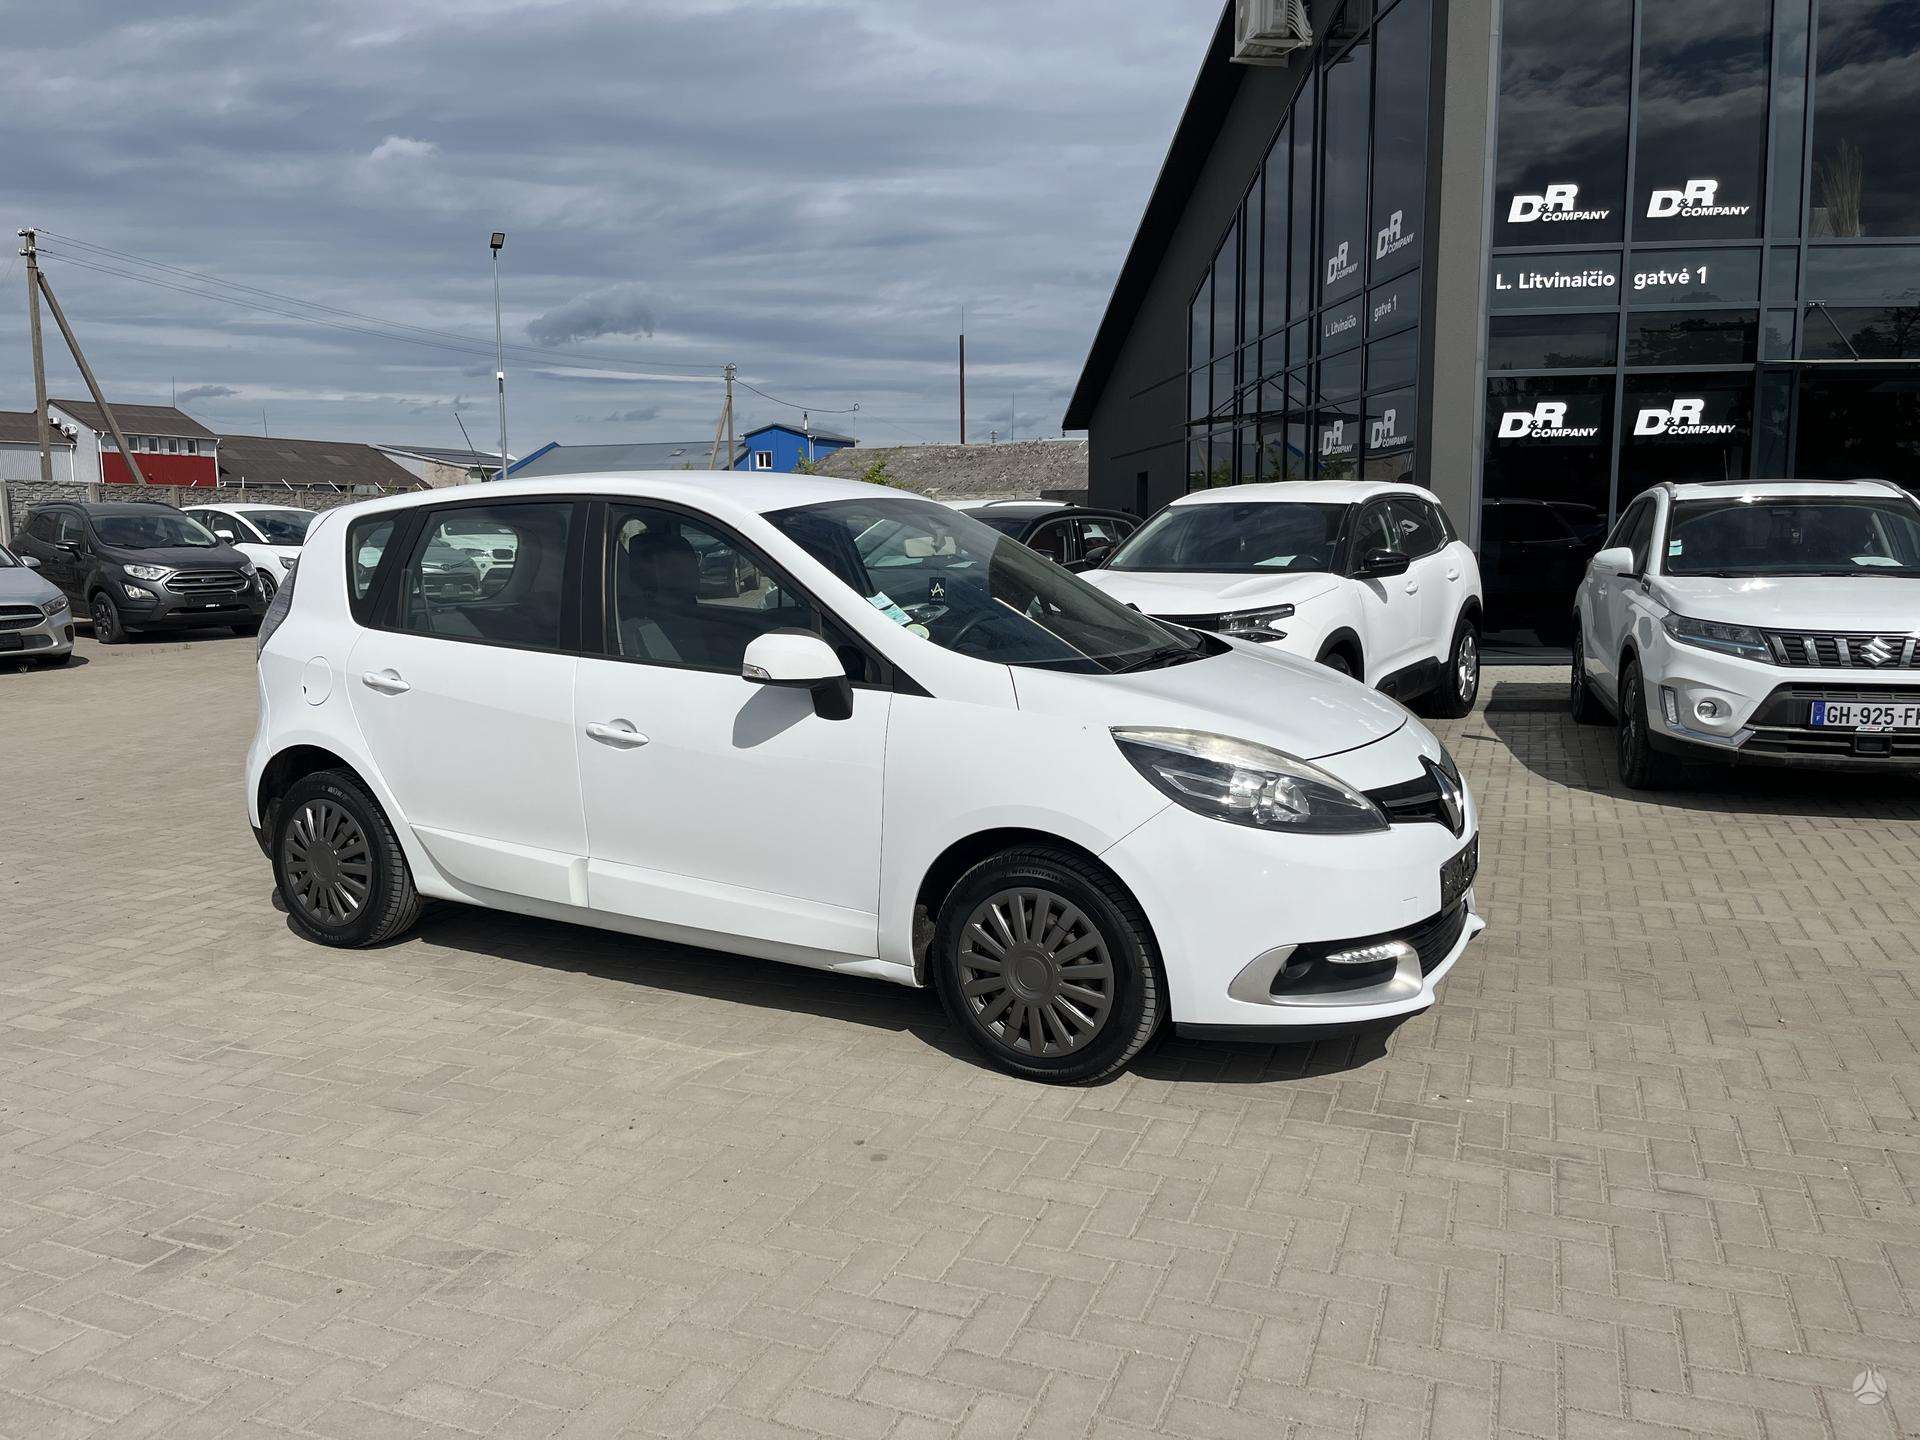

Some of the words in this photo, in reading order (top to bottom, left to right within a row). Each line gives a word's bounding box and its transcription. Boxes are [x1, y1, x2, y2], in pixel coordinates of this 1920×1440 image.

[1508, 184, 1578, 223] D&R
[1646, 180, 1718, 217] D&R
[1542, 210, 1609, 222] COMPANY
[1681, 206, 1749, 217] COMPANY
[1388, 232, 1415, 254] COMPANY
[1496, 273, 1512, 290] L.
[1519, 270, 1616, 289] Litvinaičio
[1633, 267, 1690, 290] gatvė
[1696, 266, 1707, 284] 1
[1498, 402, 1567, 438] D&R
[1633, 399, 1704, 435] D&R
[1531, 428, 1598, 438] COMPANY
[1668, 425, 1736, 435] COMPANY
[1382, 436, 1408, 447] COMPANY
